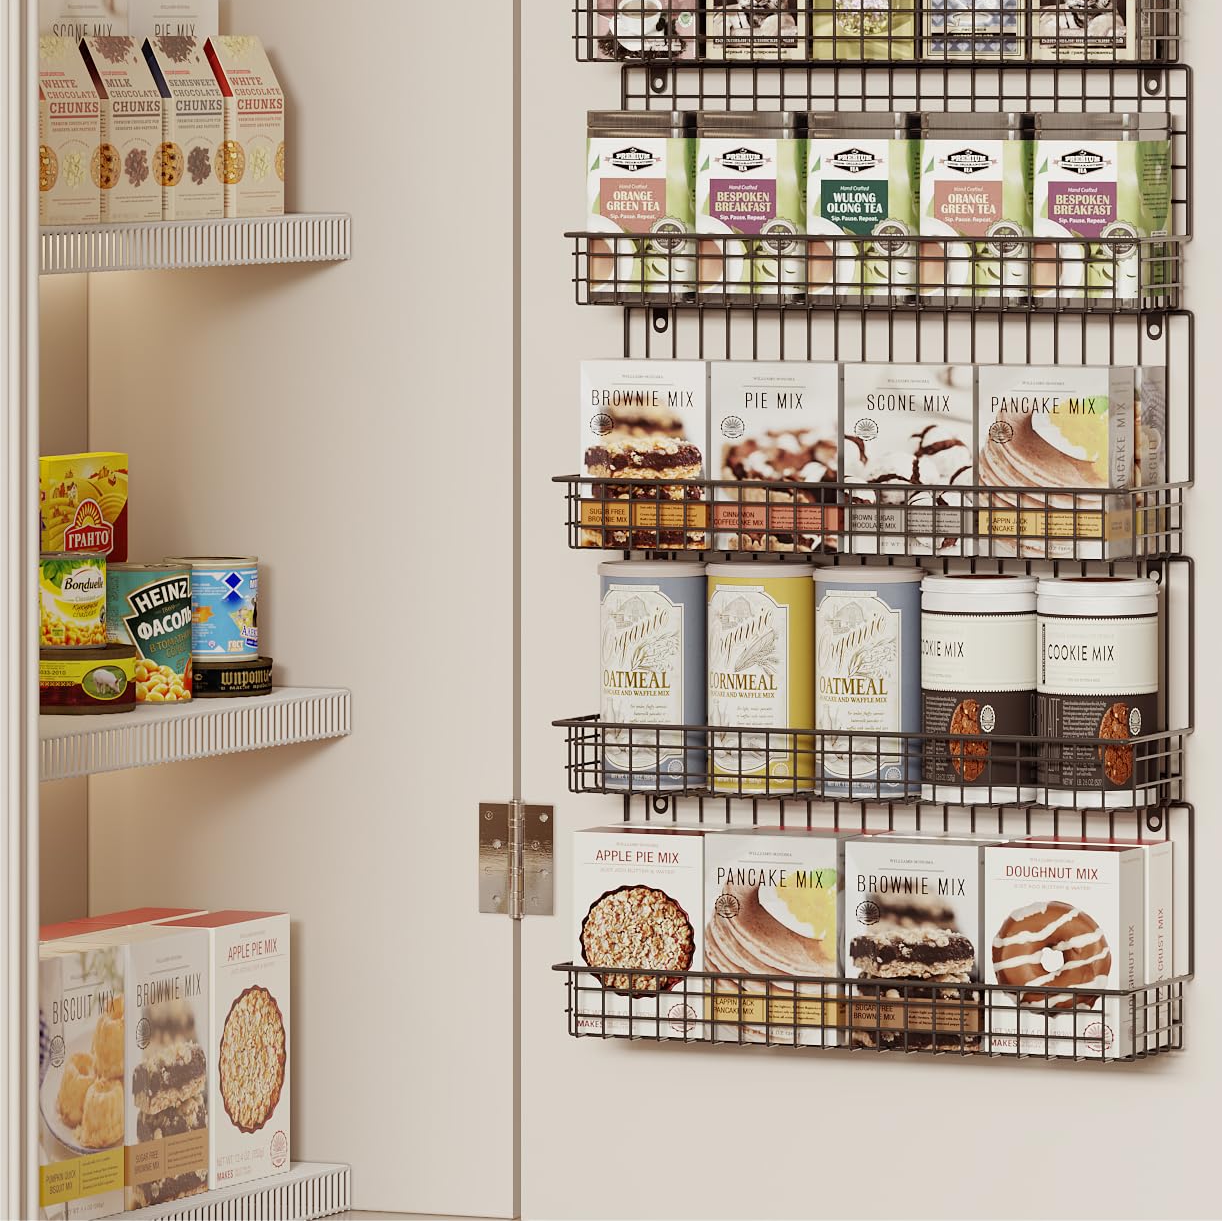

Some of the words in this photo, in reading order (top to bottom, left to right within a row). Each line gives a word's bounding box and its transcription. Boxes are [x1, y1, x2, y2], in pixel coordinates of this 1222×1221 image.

[42, 79, 78, 88] WHITE
[105, 79, 132, 88] MILK
[169, 79, 216, 87] SEMISWEET
[231, 77, 263, 86] WHITE
[47, 91, 97, 99] CHOCOLATE
[110, 89, 159, 98] CHOCOLATE
[173, 89, 221, 97] CHOCOLATE
[235, 87, 281, 96] CHOCOLATE
[50, 101, 99, 114] CHUNKS
[112, 100, 160, 113] CHUNKS
[176, 99, 222, 111] CHUNKS
[237, 98, 282, 110] CHUNKS
[613, 191, 652, 200] ORANGE
[717, 192, 769, 202] BESPOKEN
[833, 193, 876, 203] WULONG
[948, 194, 988, 204] ORANGE
[1056, 195, 1109, 205] BESPOKEN
[607, 202, 639, 211] GREEN
[642, 202, 660, 211] TEA
[715, 202, 772, 212] BREAKFAST
[827, 203, 862, 213] OLONG
[865, 203, 883, 213] TEA
[941, 204, 974, 214] GREEN
[978, 205, 996, 215] TEA
[1054, 205, 1112, 215] BREAKFAST
[591, 390, 659, 407] BROWNIE
[668, 391, 694, 407] MIX
[745, 392, 768, 409] PIE
[777, 393, 803, 410] MIX
[867, 394, 916, 412] SCONE
[924, 395, 950, 412] MIX
[991, 396, 1060, 414] PANCAKE
[1069, 398, 1096, 415] MIX
[68, 531, 109, 549] ГРАНТО
[135, 581, 187, 614] HEINZ
[137, 606, 192, 640] ФАСОЛЬ
[944, 641, 964, 657] MIX
[1048, 644, 1088, 661] COOKIE
[1092, 645, 1115, 661] MIX
[604, 670, 670, 688] OATMEAL
[710, 672, 777, 690] CORNMEAL
[820, 677, 888, 695] OATMEAL
[596, 850, 632, 861] APPLE
[636, 851, 653, 862] PIE
[658, 852, 679, 863] MIX
[716, 867, 788, 888] PANCAKE
[796, 870, 823, 889] MIX
[1006, 865, 1072, 878] DOUGHNUT
[1076, 868, 1098, 879] MIX
[856, 874, 929, 896] BROWNIE
[938, 877, 966, 897] MIX
[228, 943, 250, 962] APPLE
[252, 941, 263, 955] PIE
[264, 938, 277, 954] MIX
[136, 976, 180, 1008] BROWNIE
[185, 973, 201, 997] MIX
[52, 993, 92, 1025] BISCUIT
[98, 989, 116, 1013] MIX
[217, 1170, 234, 1180] MAKES
